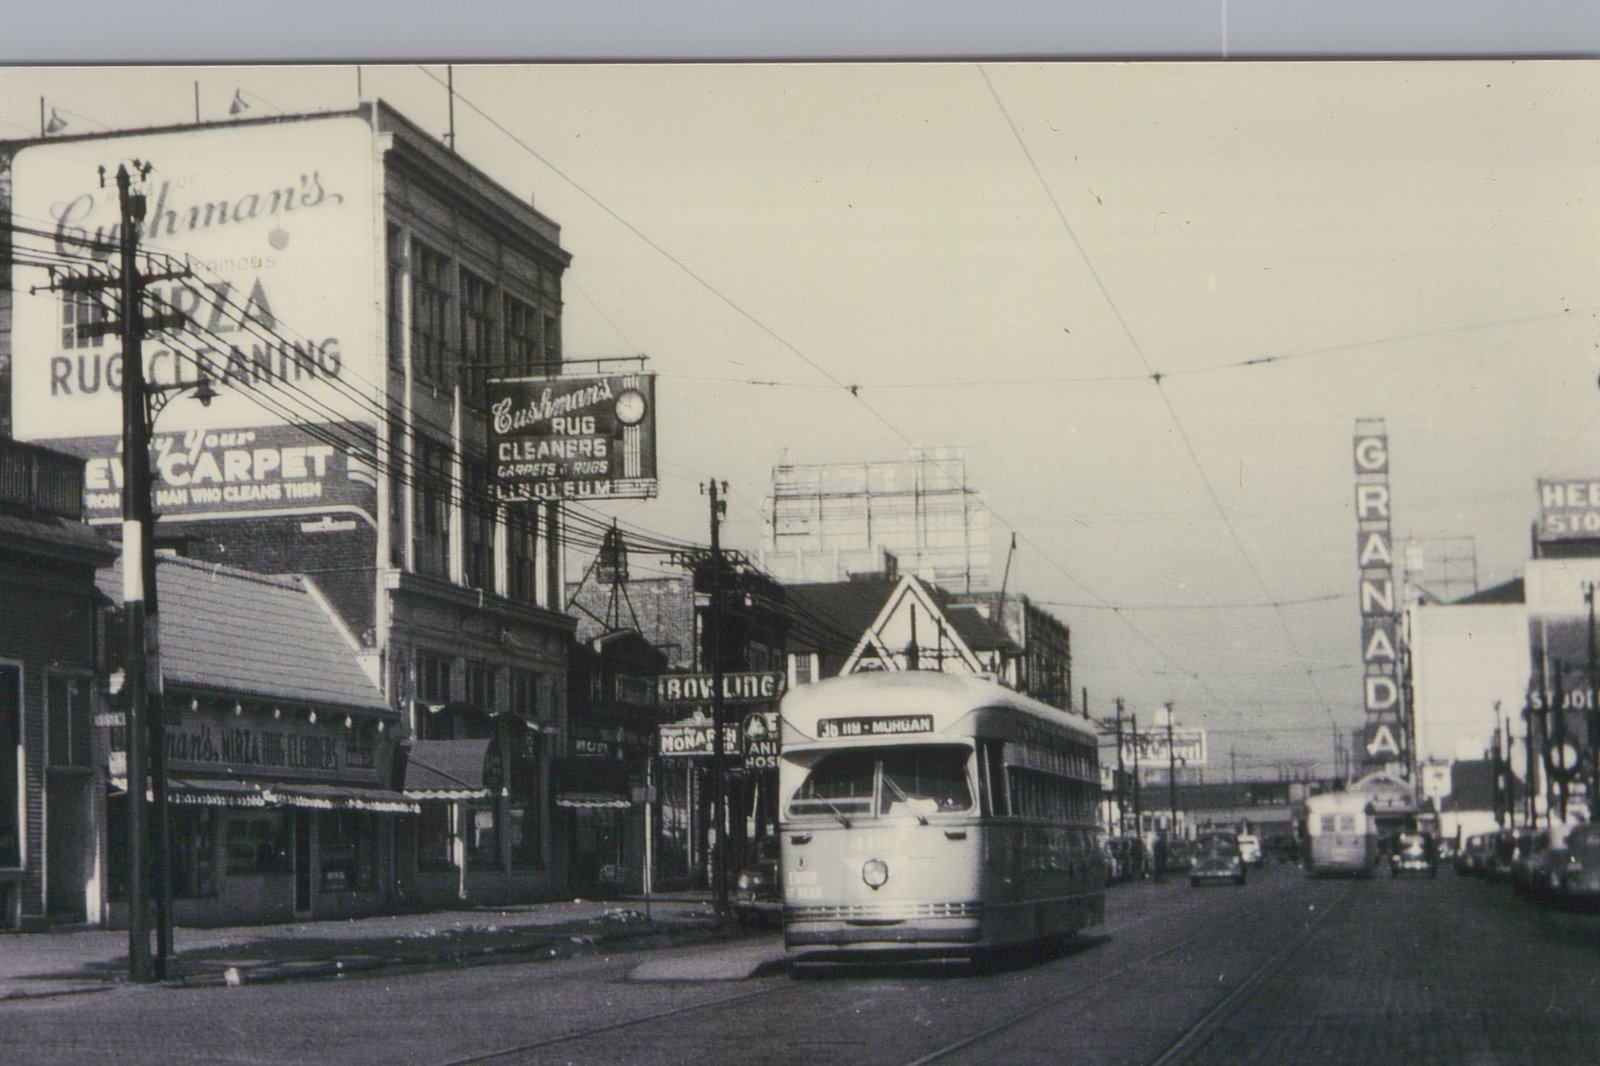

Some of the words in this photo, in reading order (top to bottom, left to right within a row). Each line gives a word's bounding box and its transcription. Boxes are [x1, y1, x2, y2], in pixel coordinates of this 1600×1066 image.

[50, 170, 345, 259] Cuhman's
[50, 352, 123, 396] RUG
[148, 337, 342, 388] CLEANING
[492, 378, 613, 434] Cushman's
[551, 416, 596, 436] RUG
[184, 429, 256, 465] Your
[498, 438, 608, 462] CLEANERS
[497, 463, 557, 478] CARPETS
[573, 460, 609, 476] RUGS
[156, 488, 189, 506] MAN
[190, 485, 221, 503] WHO
[223, 483, 282, 502] CLEANS
[284, 481, 322, 499] THEM
[496, 480, 611, 499] LINOLEUM
[1355, 437, 1401, 757] GRANADA
